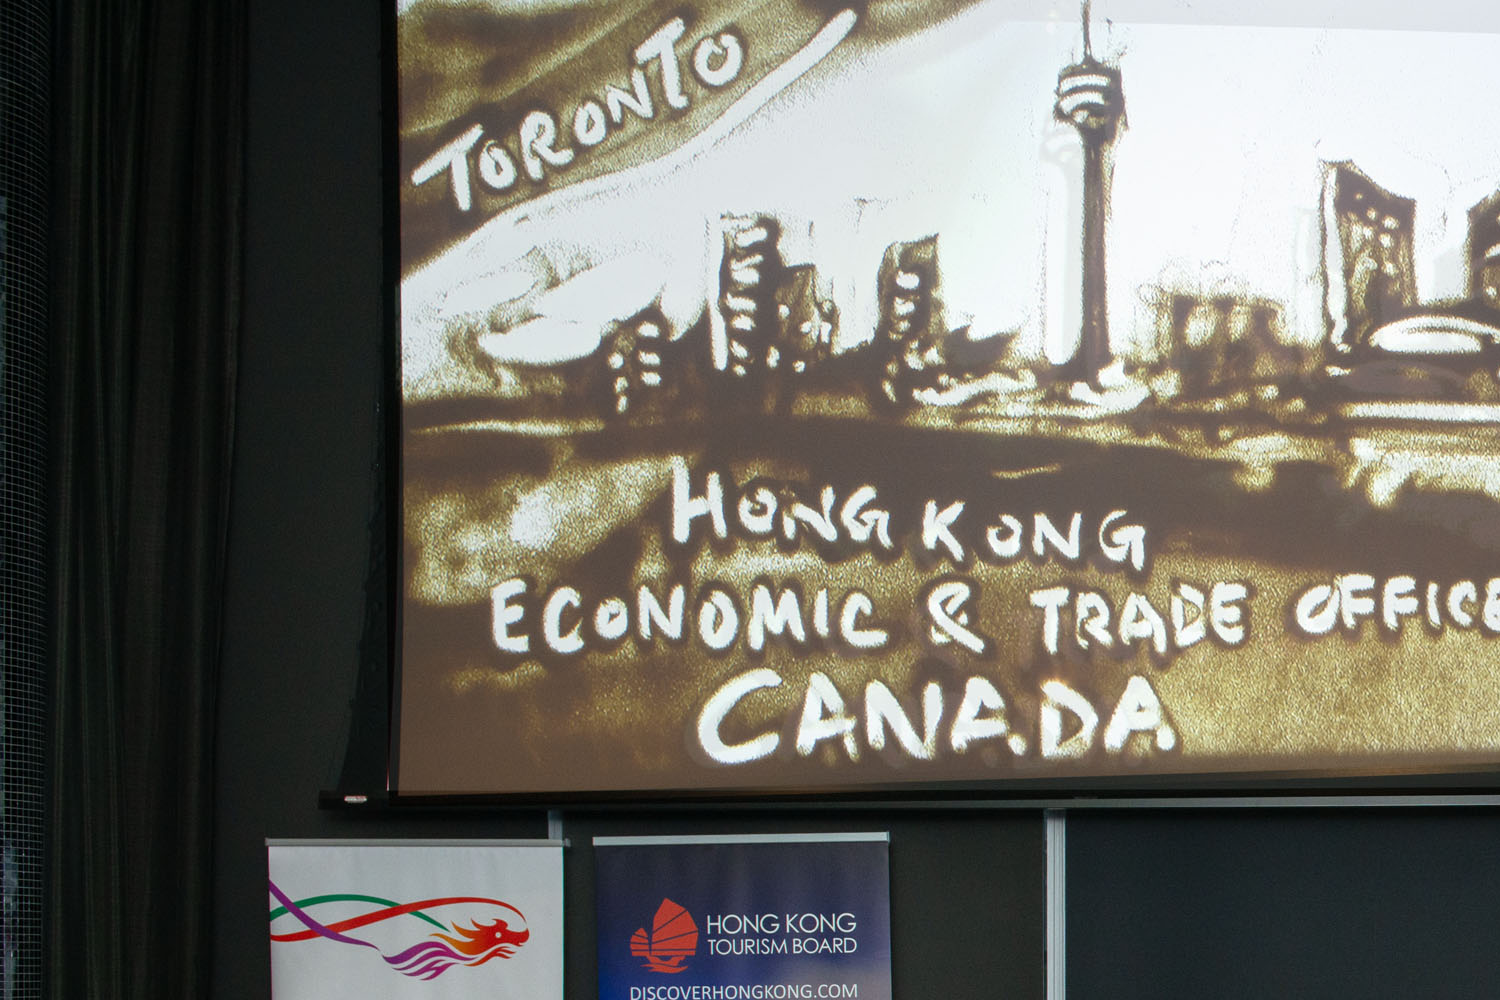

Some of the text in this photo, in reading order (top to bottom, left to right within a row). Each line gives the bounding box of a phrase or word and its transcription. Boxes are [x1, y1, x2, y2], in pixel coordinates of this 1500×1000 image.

[411, 16, 743, 211] TORONTO
[670, 455, 1147, 571] HONG KONG
[490, 578, 888, 654] ECONOMIC
[928, 582, 985, 654] &
[1029, 581, 1247, 655] TRADE
[698, 667, 1176, 764] CANADA
[707, 912, 857, 935] HONG KONG
[707, 937, 858, 956] TOURISM BOARD
